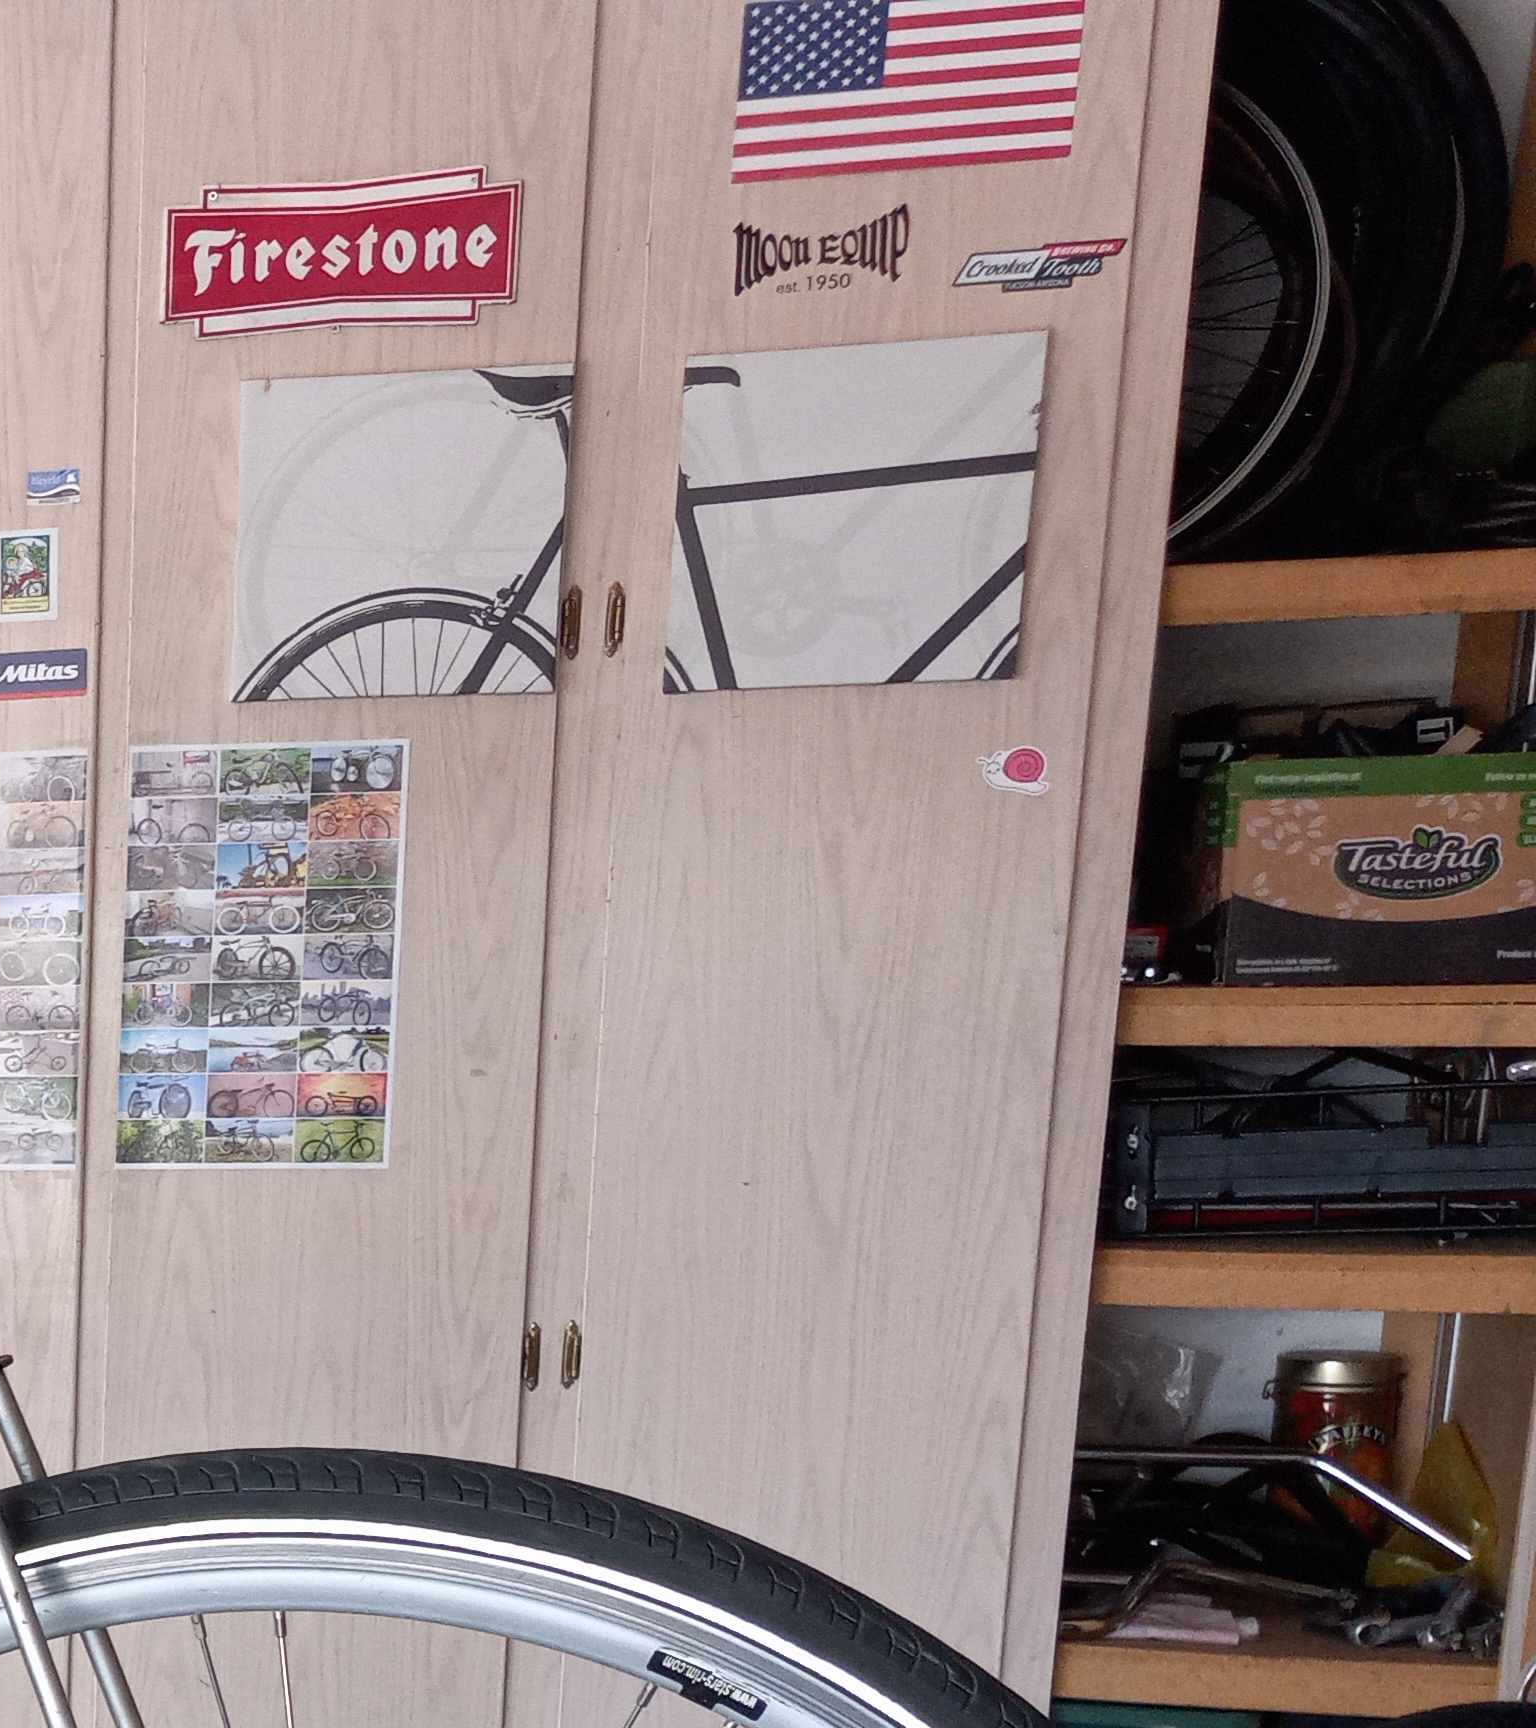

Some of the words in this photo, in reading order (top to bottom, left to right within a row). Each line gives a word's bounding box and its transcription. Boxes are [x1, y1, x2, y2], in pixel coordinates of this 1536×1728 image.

[184, 223, 497, 297] Firestone
[966, 256, 1040, 279] Crooked
[1043, 257, 1100, 278] Tooth
[776, 281, 801, 294] est.
[806, 273, 851, 291] 1950
[1340, 838, 1496, 875] Tasteful
[1357, 871, 1473, 890] SELECTIONS
[662, 1655, 758, 1709] www.stars-rim.com
